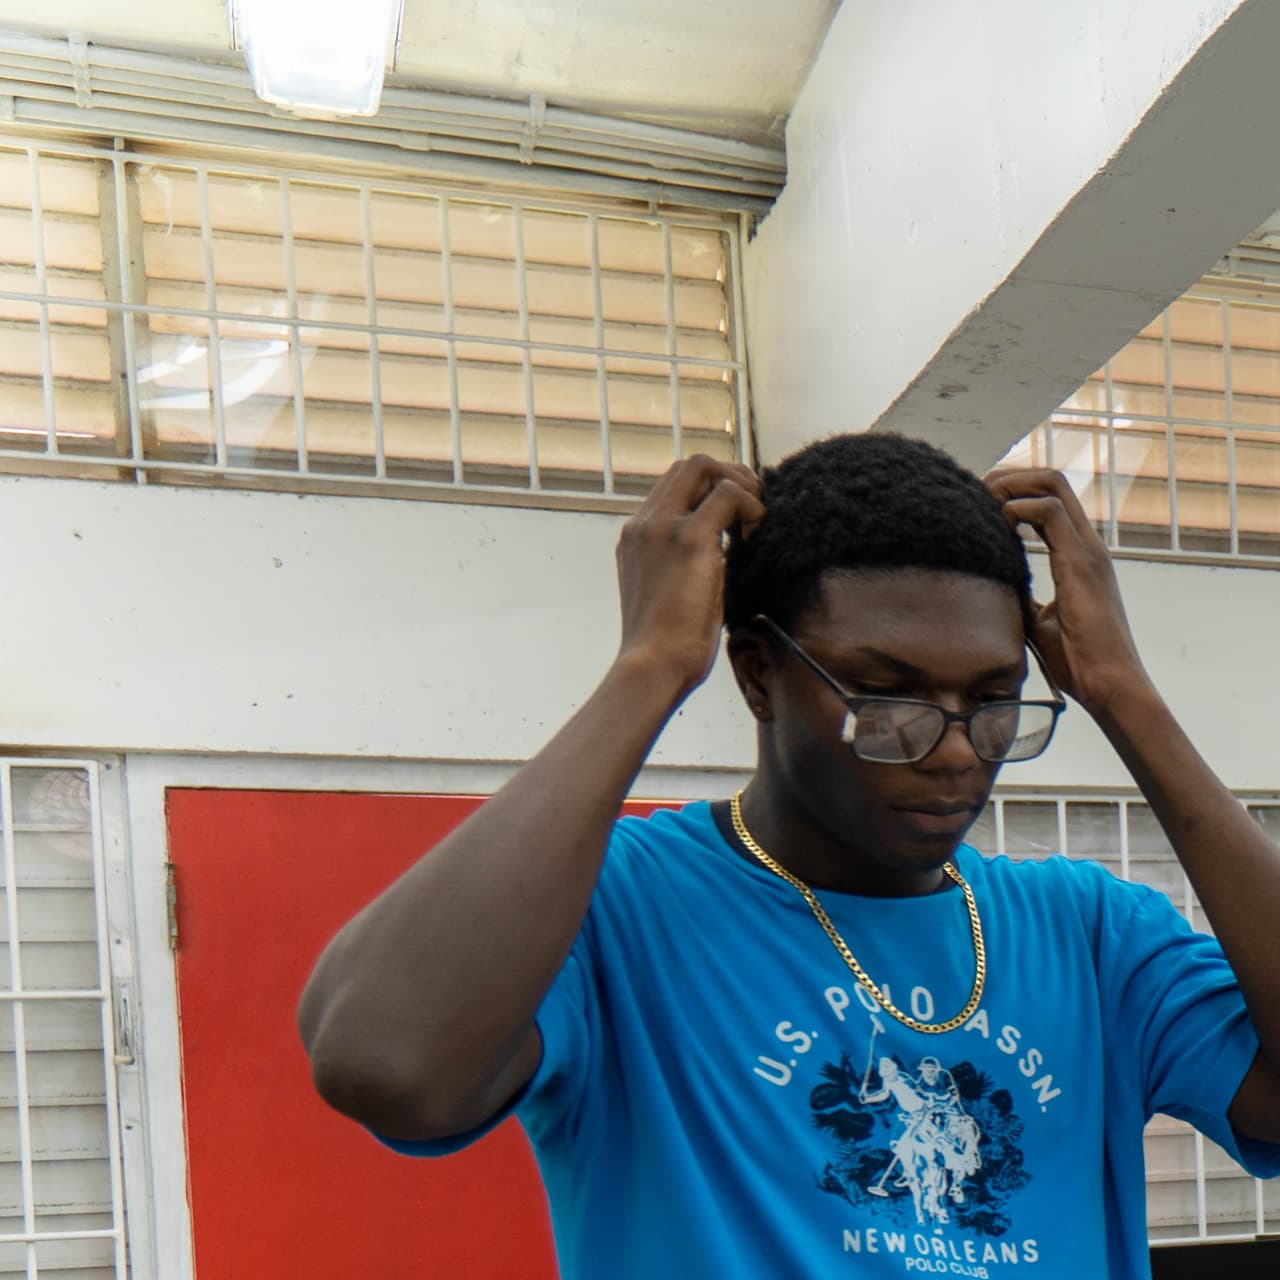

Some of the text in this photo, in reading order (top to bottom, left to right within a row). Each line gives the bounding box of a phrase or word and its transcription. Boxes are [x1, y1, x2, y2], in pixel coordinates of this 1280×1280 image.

[753, 1021, 819, 1087] U.S.
[963, 1008, 1062, 1113] ASSN.
[843, 1229, 1039, 1264] NEW ORLEANS
[905, 1257, 989, 1280] POLO CLUB
